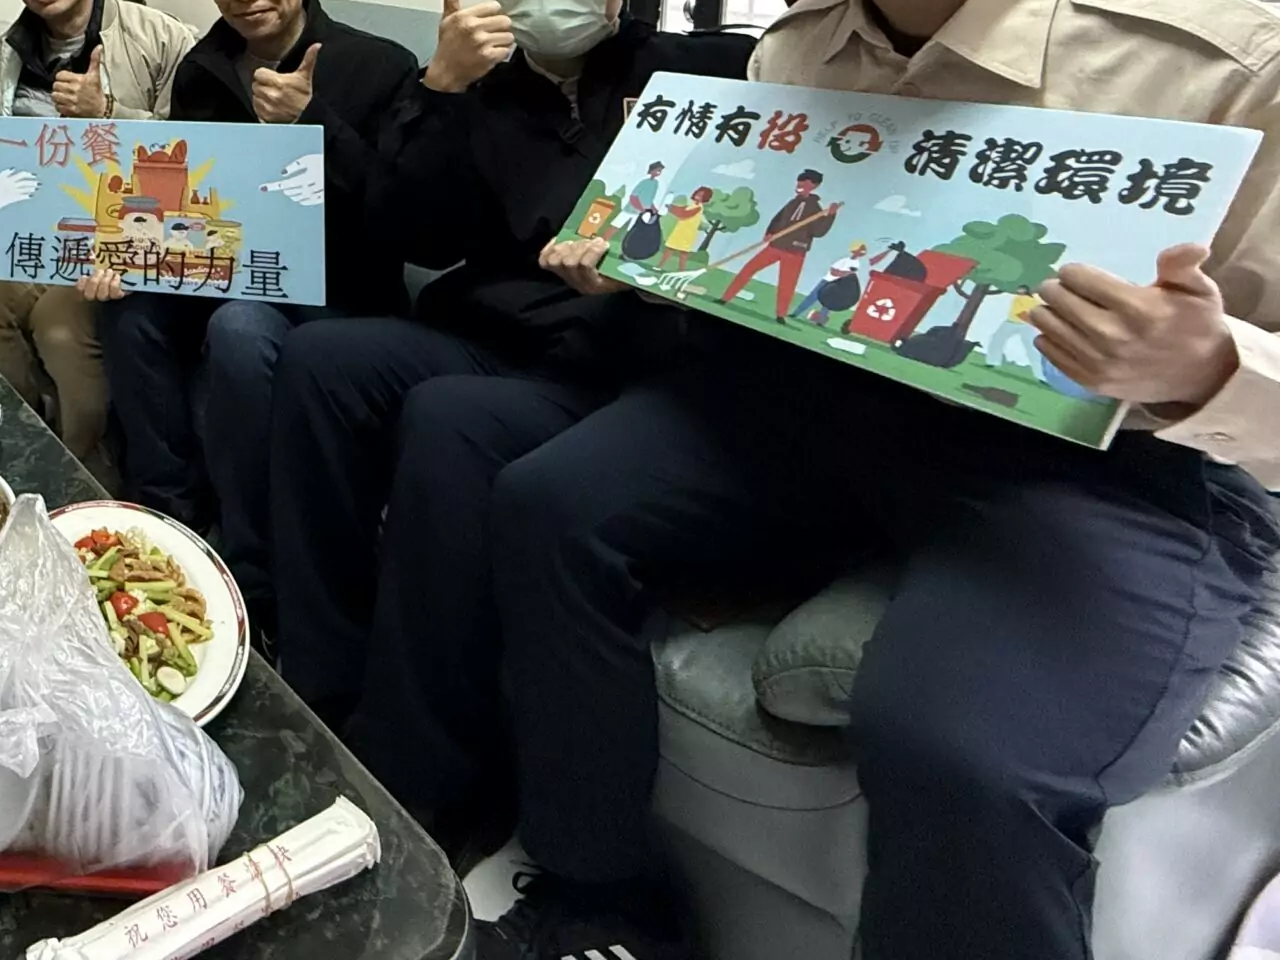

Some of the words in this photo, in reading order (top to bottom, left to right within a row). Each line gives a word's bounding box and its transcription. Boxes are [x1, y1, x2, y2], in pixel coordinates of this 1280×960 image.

[635, 94, 811, 155] 有情有役
[904, 128, 1215, 217] 清潔環境
[5, 231, 290, 300] 傳遞愛的力量
